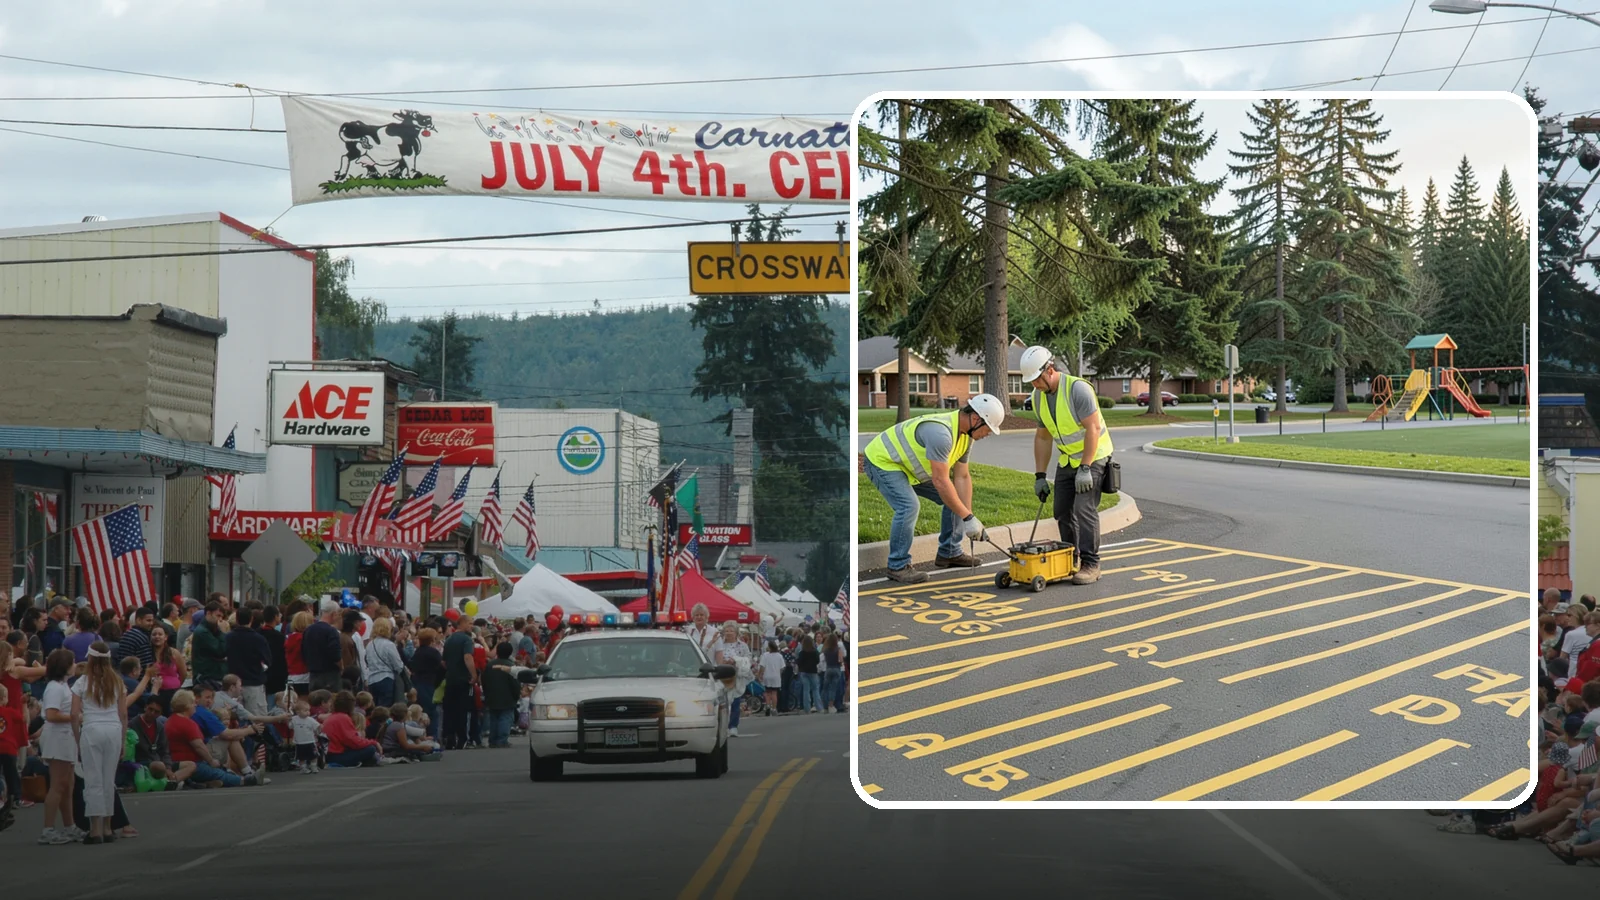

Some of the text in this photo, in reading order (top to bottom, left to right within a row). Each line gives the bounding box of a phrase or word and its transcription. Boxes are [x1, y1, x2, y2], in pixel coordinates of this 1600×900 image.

[695, 121, 850, 150] Carnat
[481, 140, 605, 192] JULY
[632, 149, 746, 198] 4th.
[697, 254, 850, 280] CROSSWA
[282, 380, 374, 420] ACE
[406, 409, 453, 422] CEDAR
[283, 421, 371, 436] Hardware
[416, 428, 477, 447] Coca-Cola
[353, 467, 386, 479] Simpl
[96, 485, 124, 494] Vincent
[126, 485, 135, 494] de
[138, 486, 155, 495] Paul
[688, 526, 742, 535] CRNATION
[699, 535, 730, 543] GLASS
